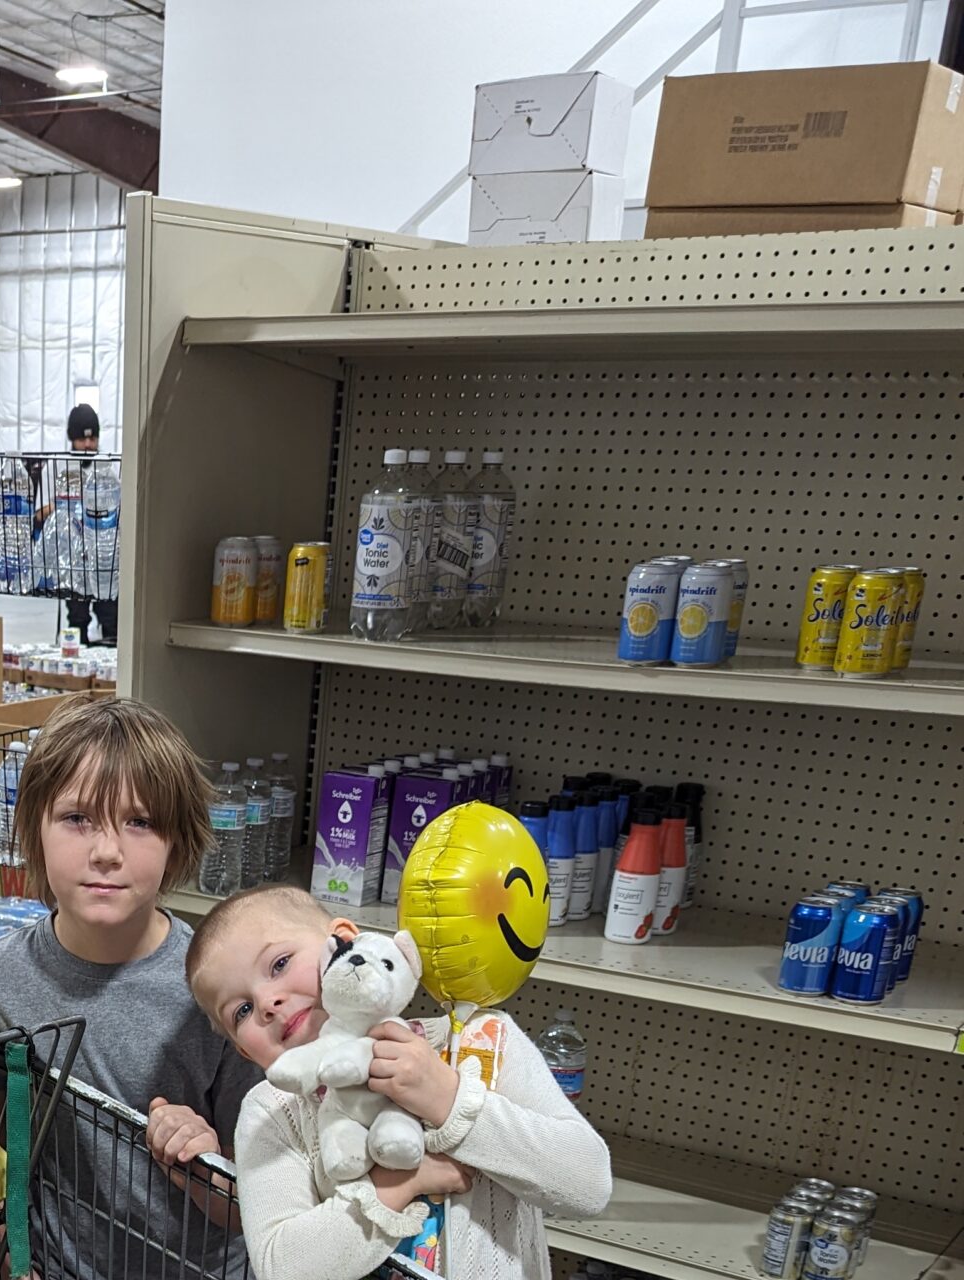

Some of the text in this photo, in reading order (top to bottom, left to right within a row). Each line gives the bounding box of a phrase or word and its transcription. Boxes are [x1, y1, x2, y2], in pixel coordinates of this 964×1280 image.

[365, 548, 389, 558] Tonic
[363, 558, 390, 568] Water
[629, 584, 667, 597] spindrift
[807, 597, 844, 623] Sole
[849, 603, 902, 629] Soleil
[332, 789, 362, 801] Schreiber
[405, 793, 437, 806] Schreiber
[329, 826, 343, 838] 1%
[819, 1250, 839, 1260] Tonic
